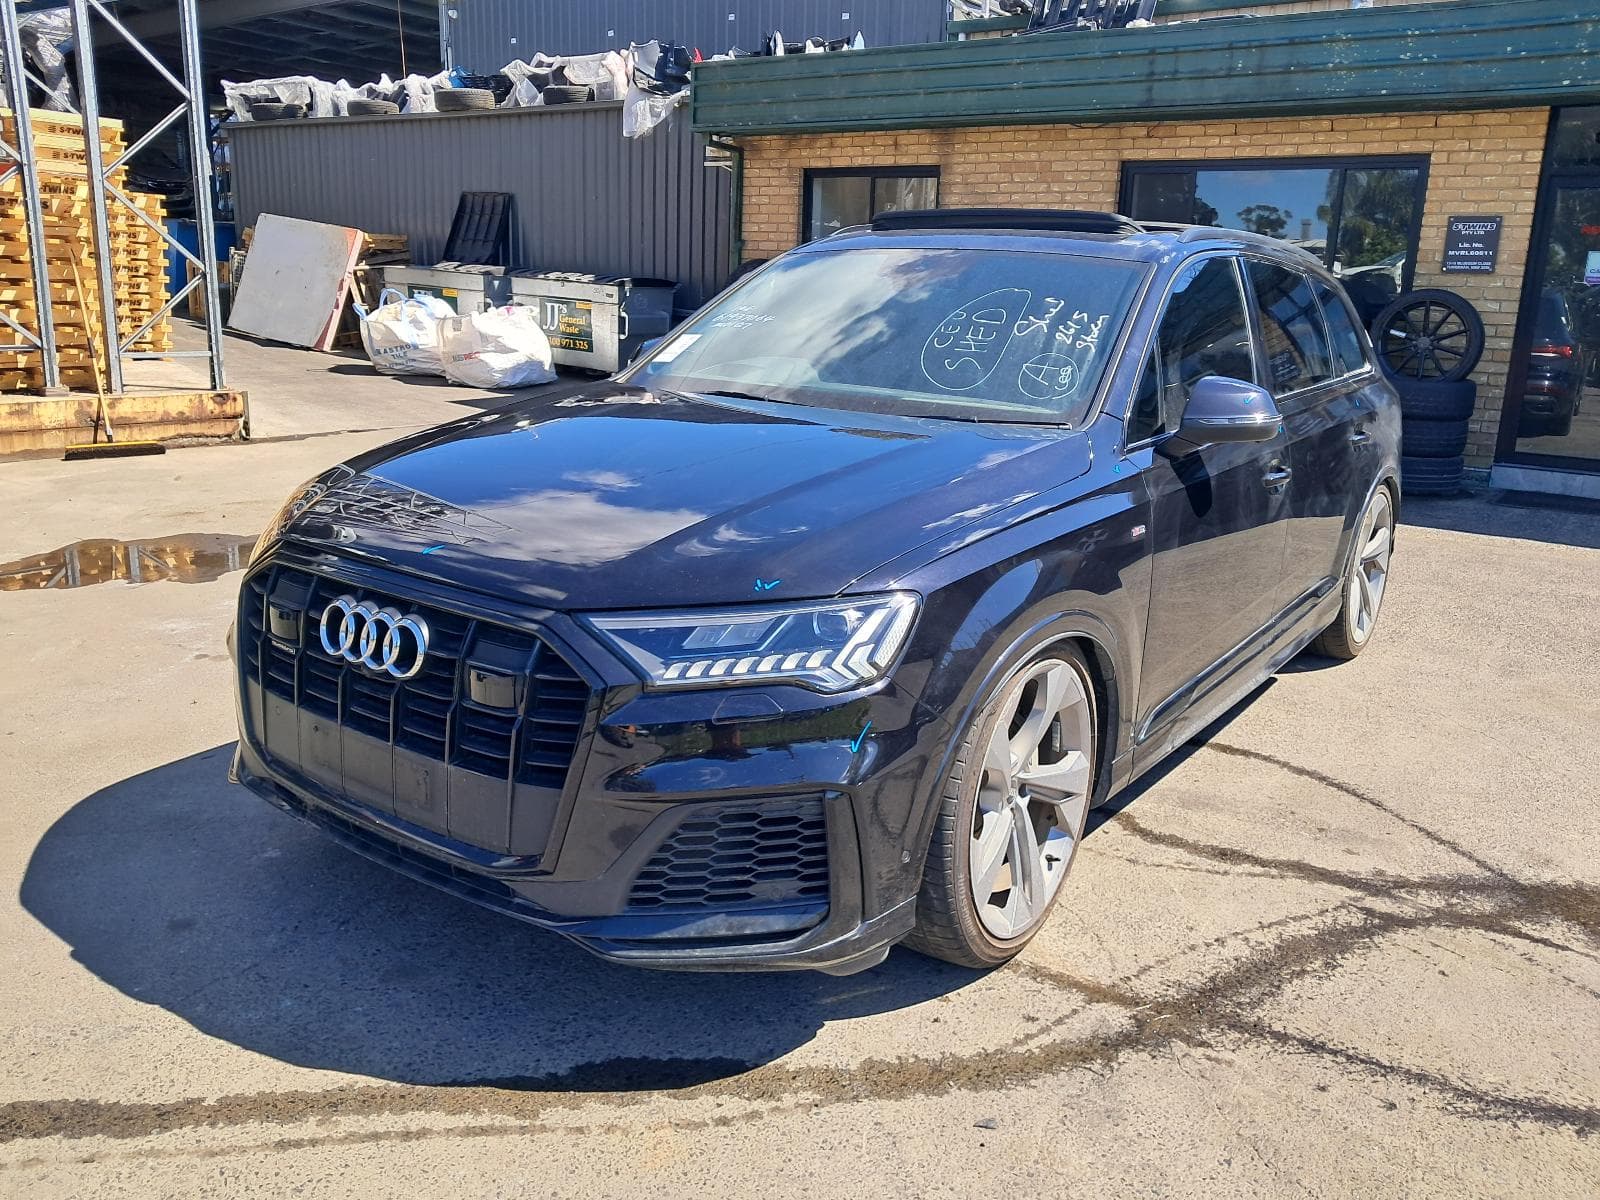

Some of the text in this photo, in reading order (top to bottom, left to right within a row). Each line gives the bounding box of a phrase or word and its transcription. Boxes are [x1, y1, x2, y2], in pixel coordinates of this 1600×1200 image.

[59, 126, 84, 136] S-TWI
[63, 152, 86, 161] S-TW
[40, 184, 75, 195] -TWINS
[559, 313, 586, 325] General
[559, 323, 580, 334] Waste
[561, 338, 574, 348] 971
[575, 340, 589, 350] 325
[944, 308, 1007, 370] SHED
